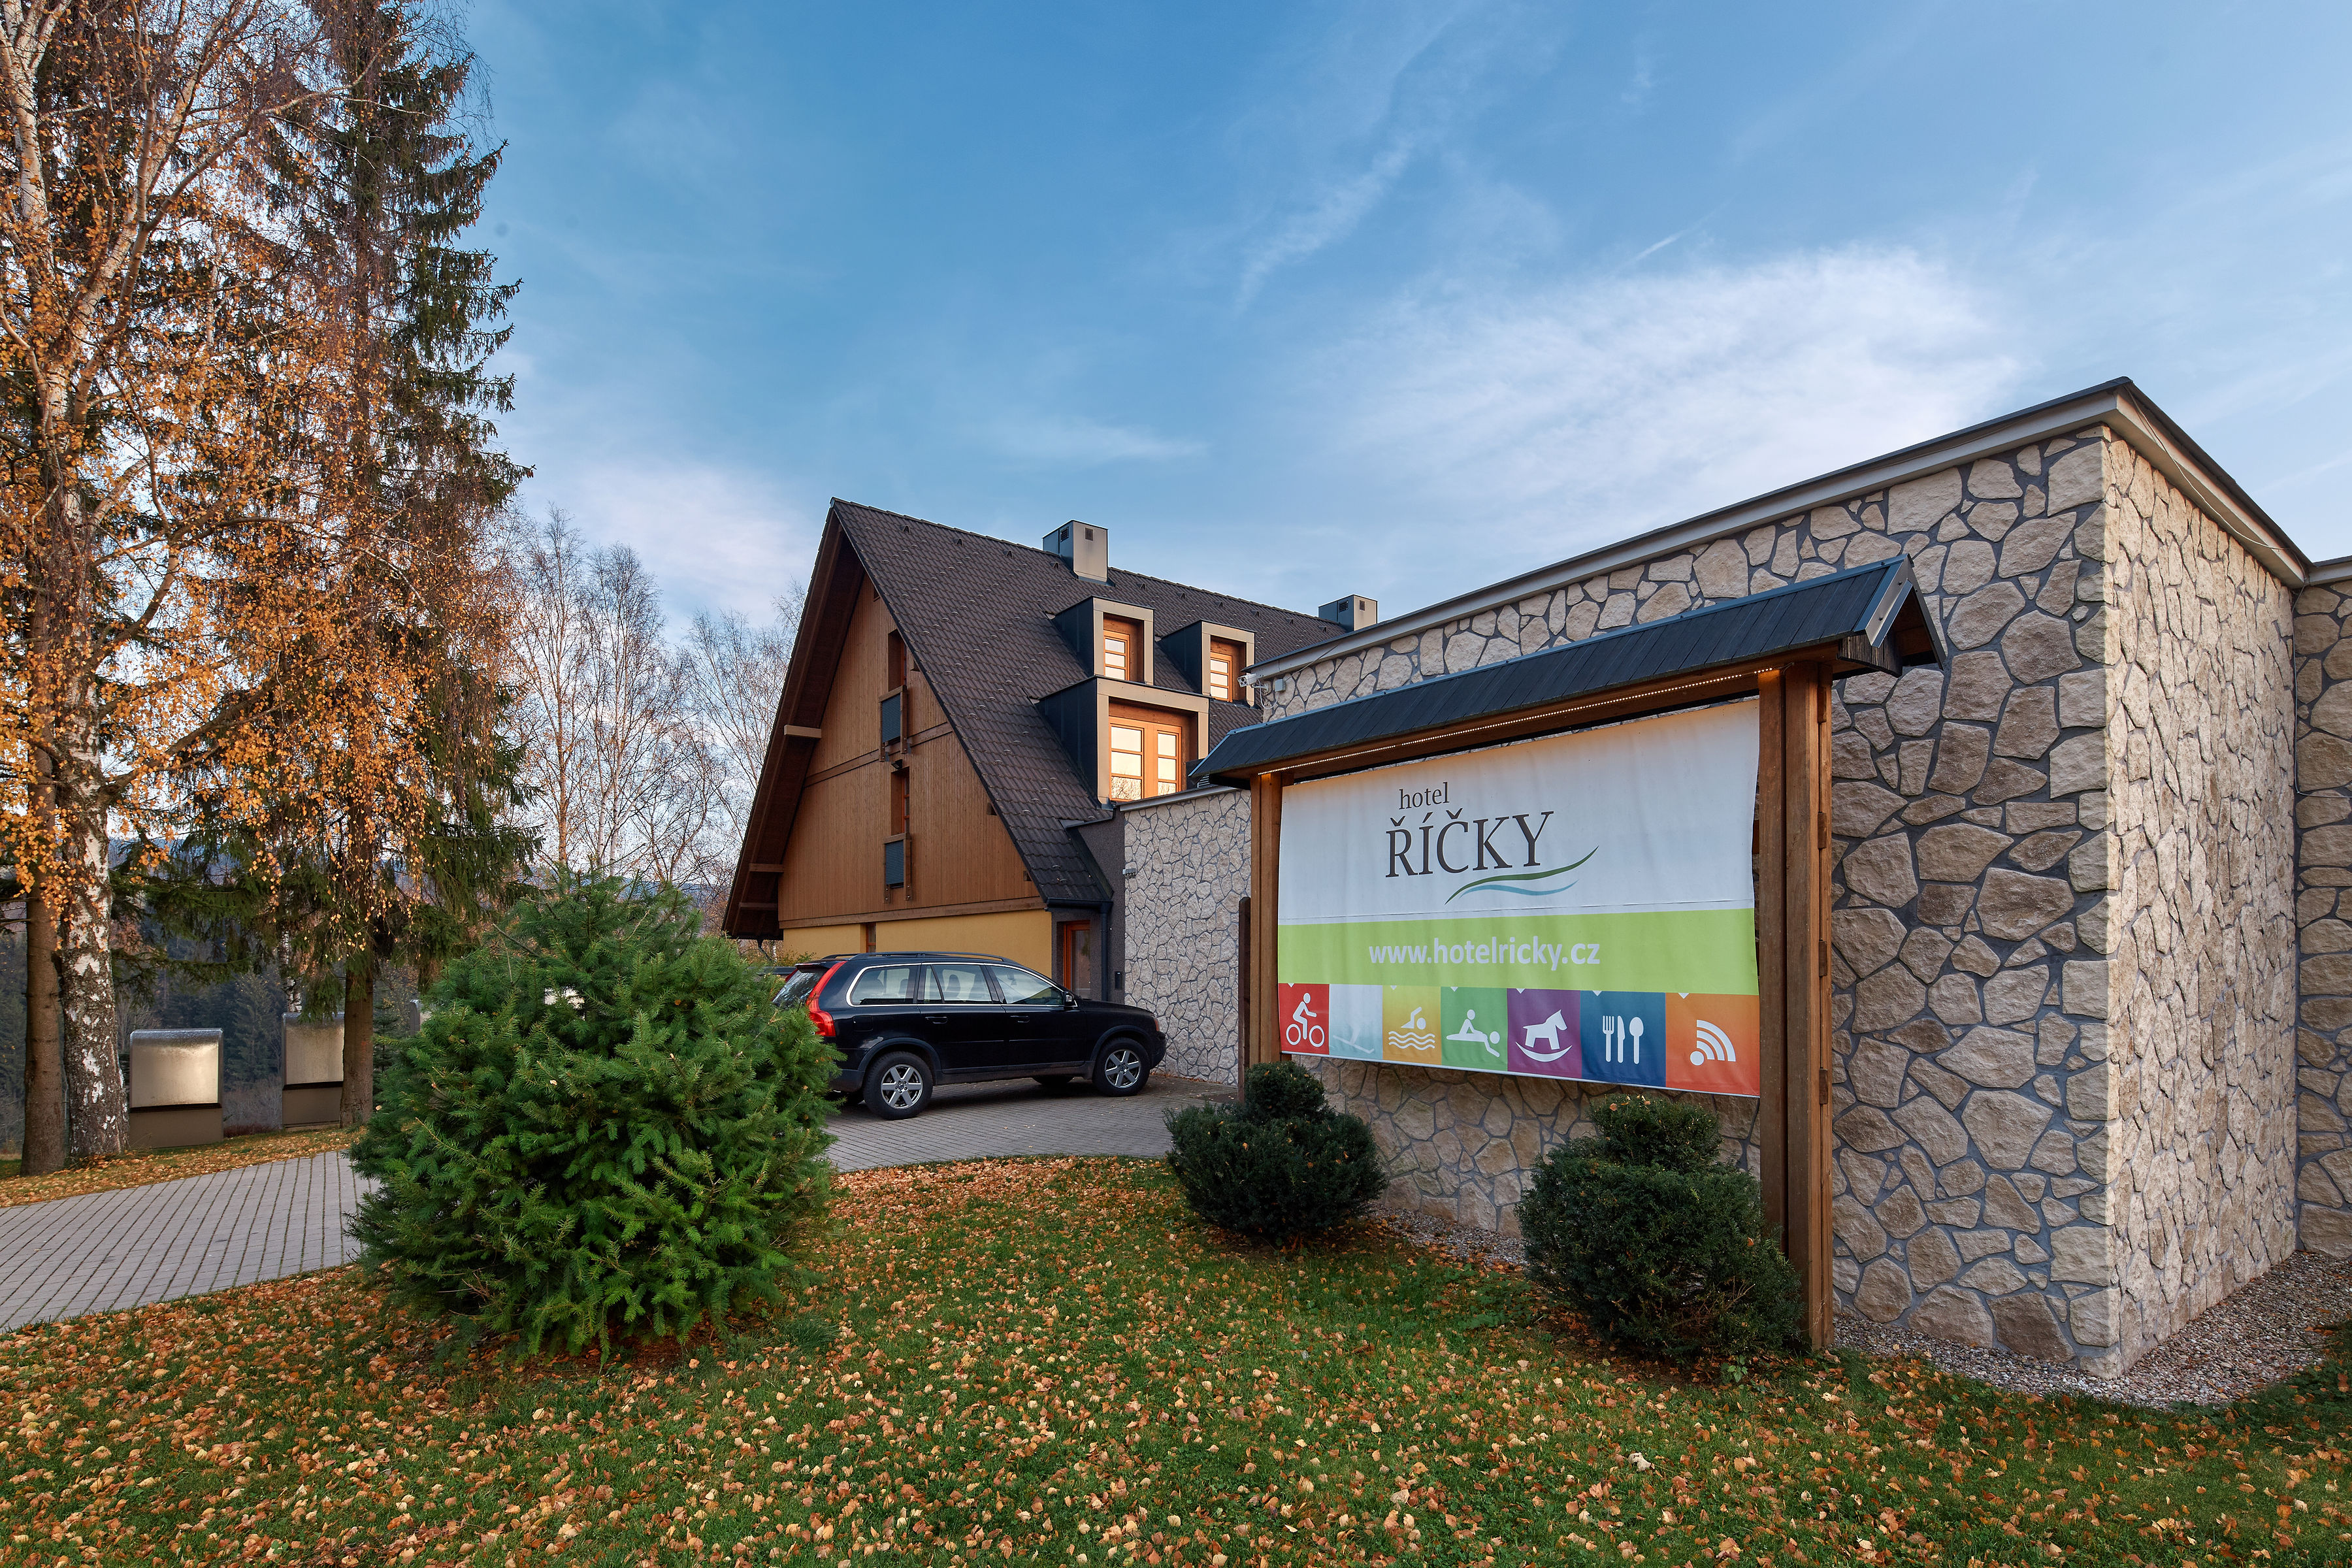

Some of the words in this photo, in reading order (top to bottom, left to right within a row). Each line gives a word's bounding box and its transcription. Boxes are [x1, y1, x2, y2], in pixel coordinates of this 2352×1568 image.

[1399, 782, 1450, 809] hotel
[1385, 808, 1554, 878] ŘÍČKY
[1369, 936, 1601, 971] www.hotelricky.cz
